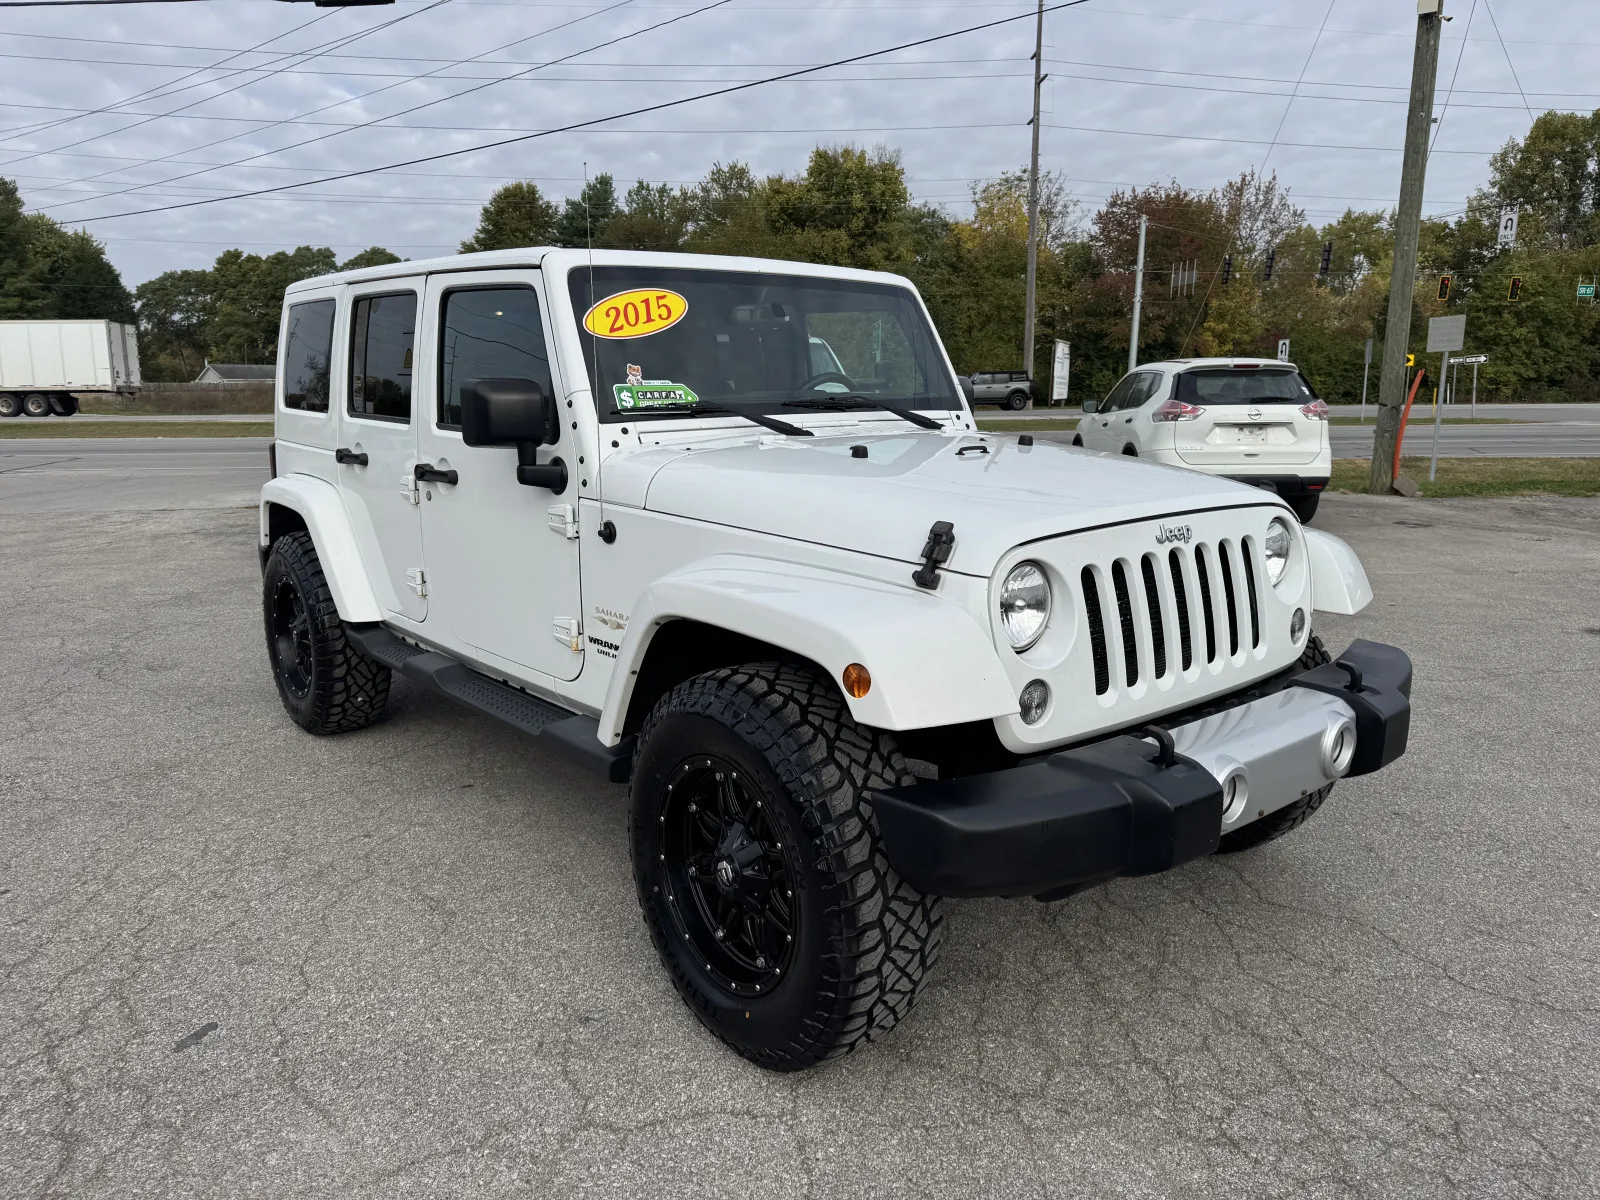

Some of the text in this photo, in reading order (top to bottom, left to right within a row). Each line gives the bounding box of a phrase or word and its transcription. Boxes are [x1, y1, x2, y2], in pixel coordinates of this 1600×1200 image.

[605, 295, 672, 334] 2015
[620, 390, 635, 409] $
[637, 390, 685, 400] CARFAX
[1155, 524, 1193, 544] Jeep
